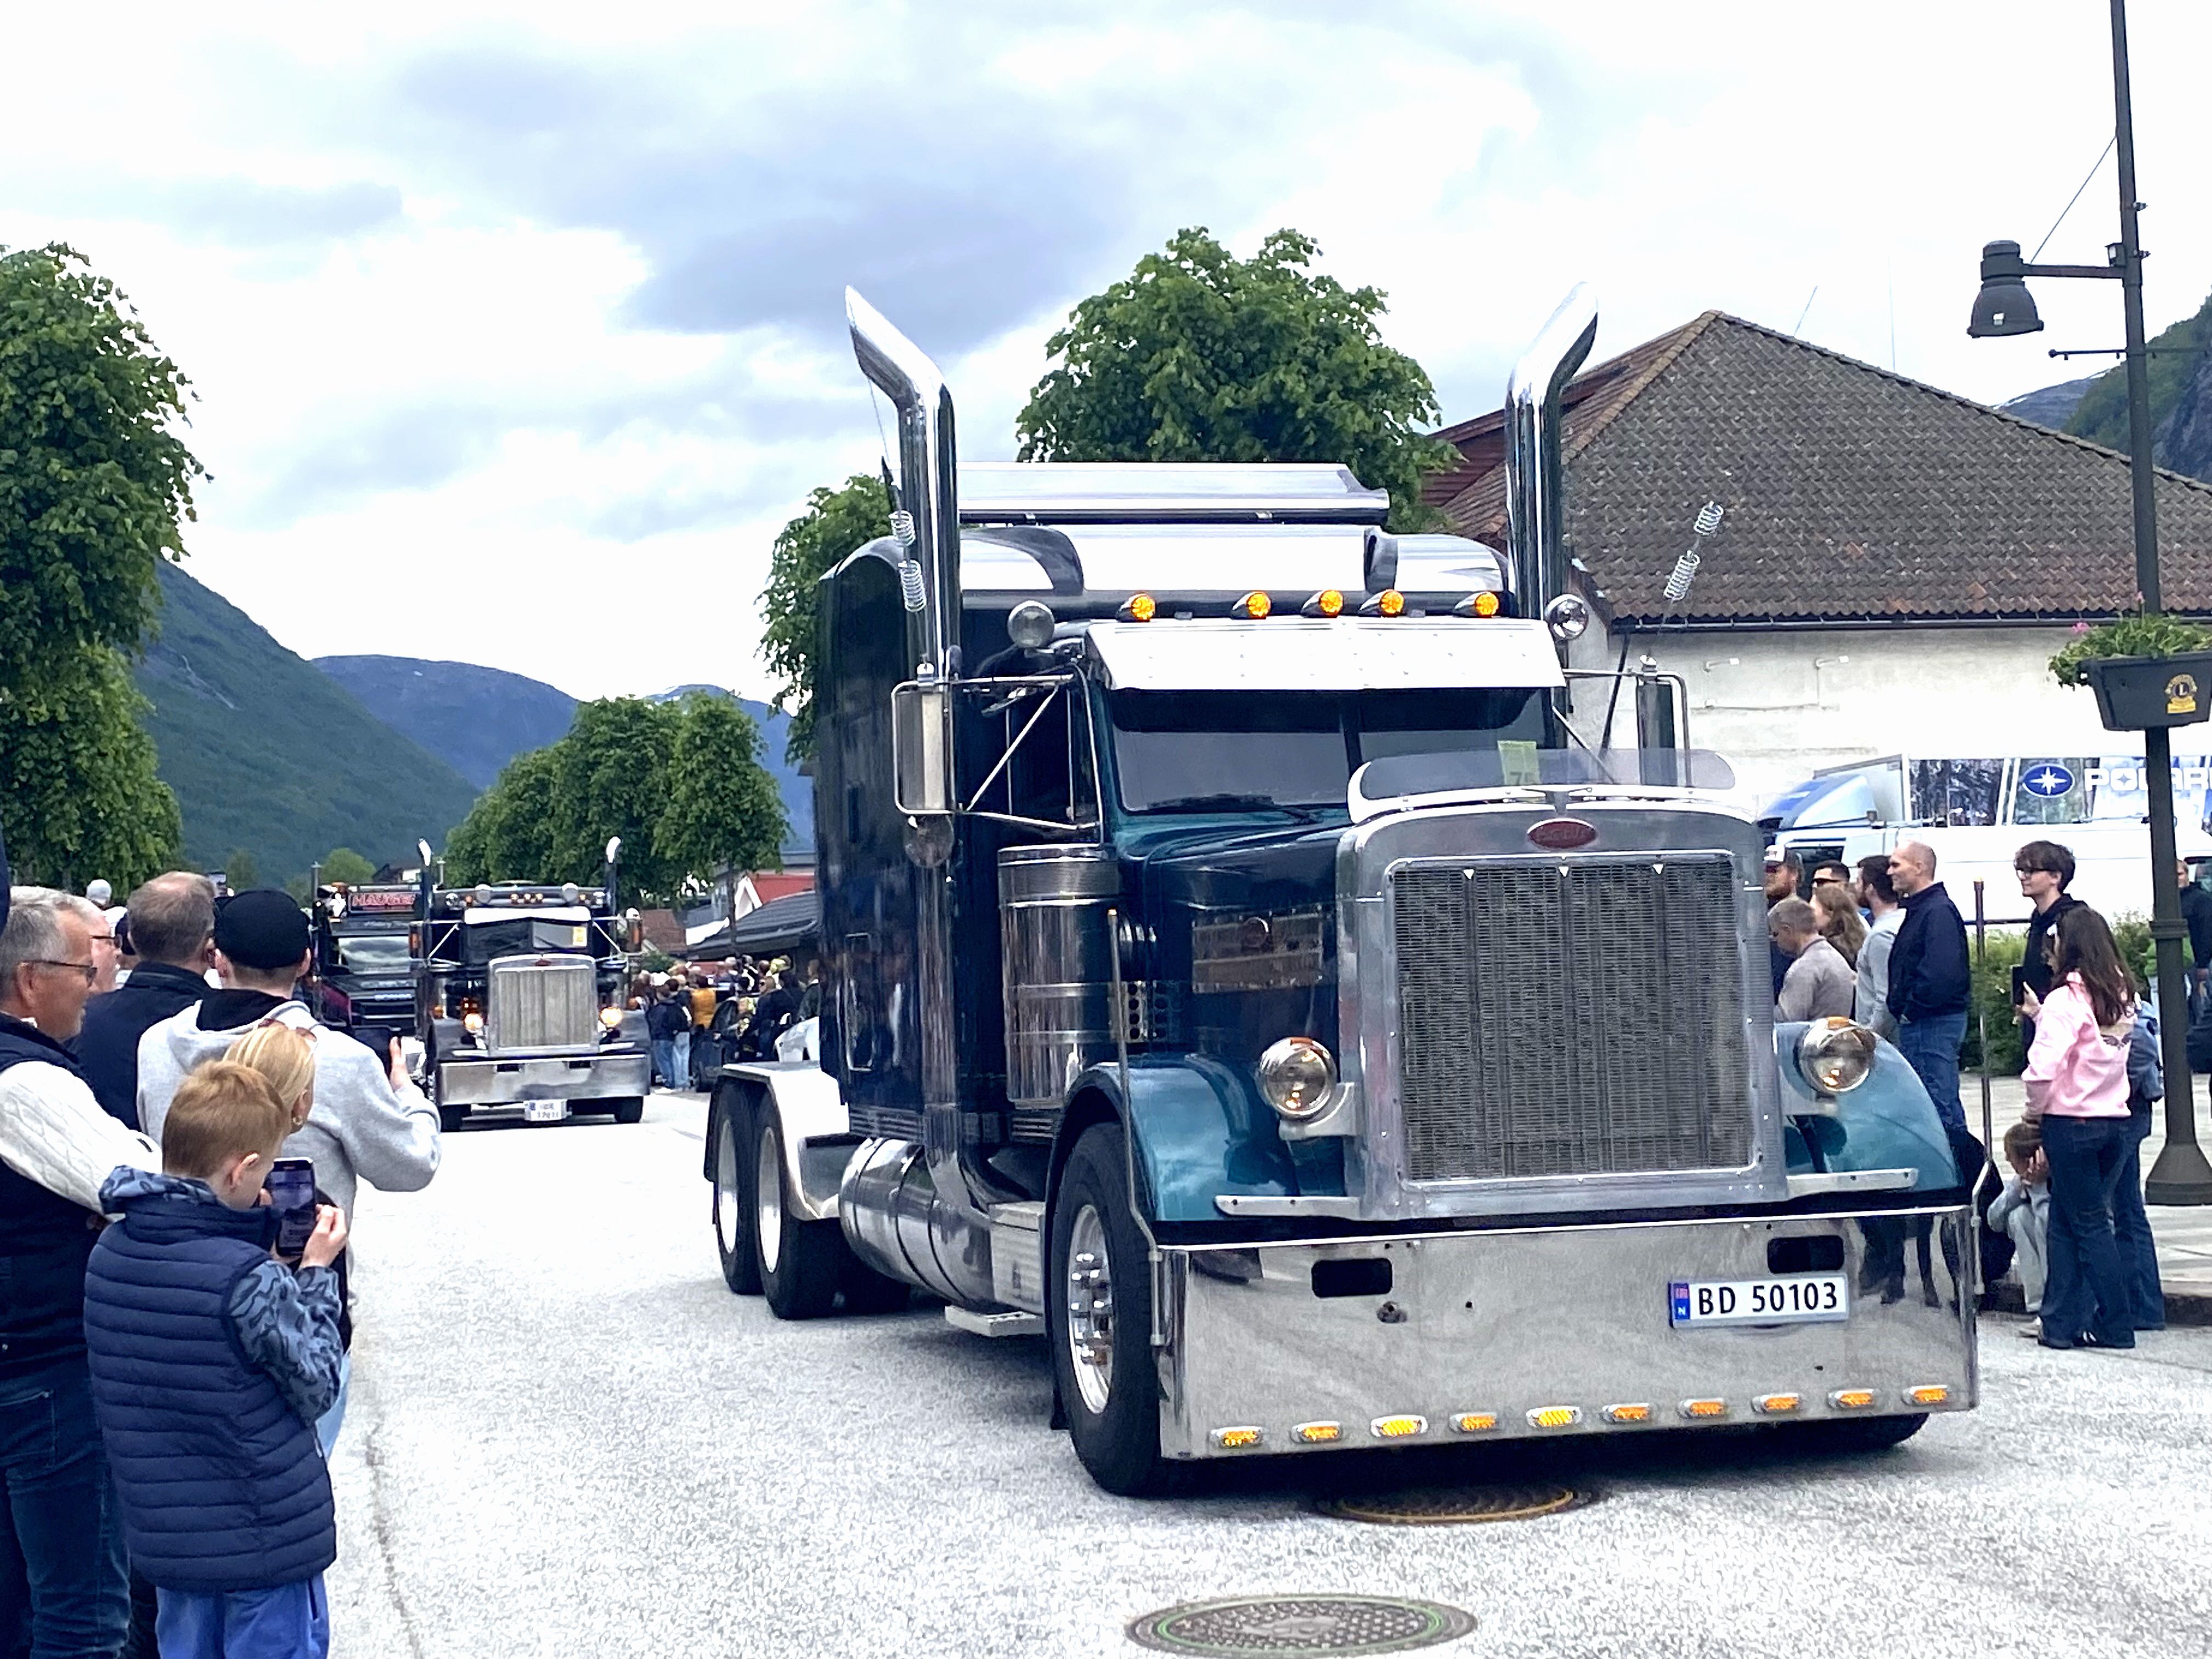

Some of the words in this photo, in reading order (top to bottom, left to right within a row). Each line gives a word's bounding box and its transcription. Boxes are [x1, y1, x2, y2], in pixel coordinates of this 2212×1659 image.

[2179, 684, 2187, 696] L
[1699, 1286, 1736, 1316] BD
[1752, 1282, 1837, 1313] 50103
[1678, 1306, 1686, 1316] N
